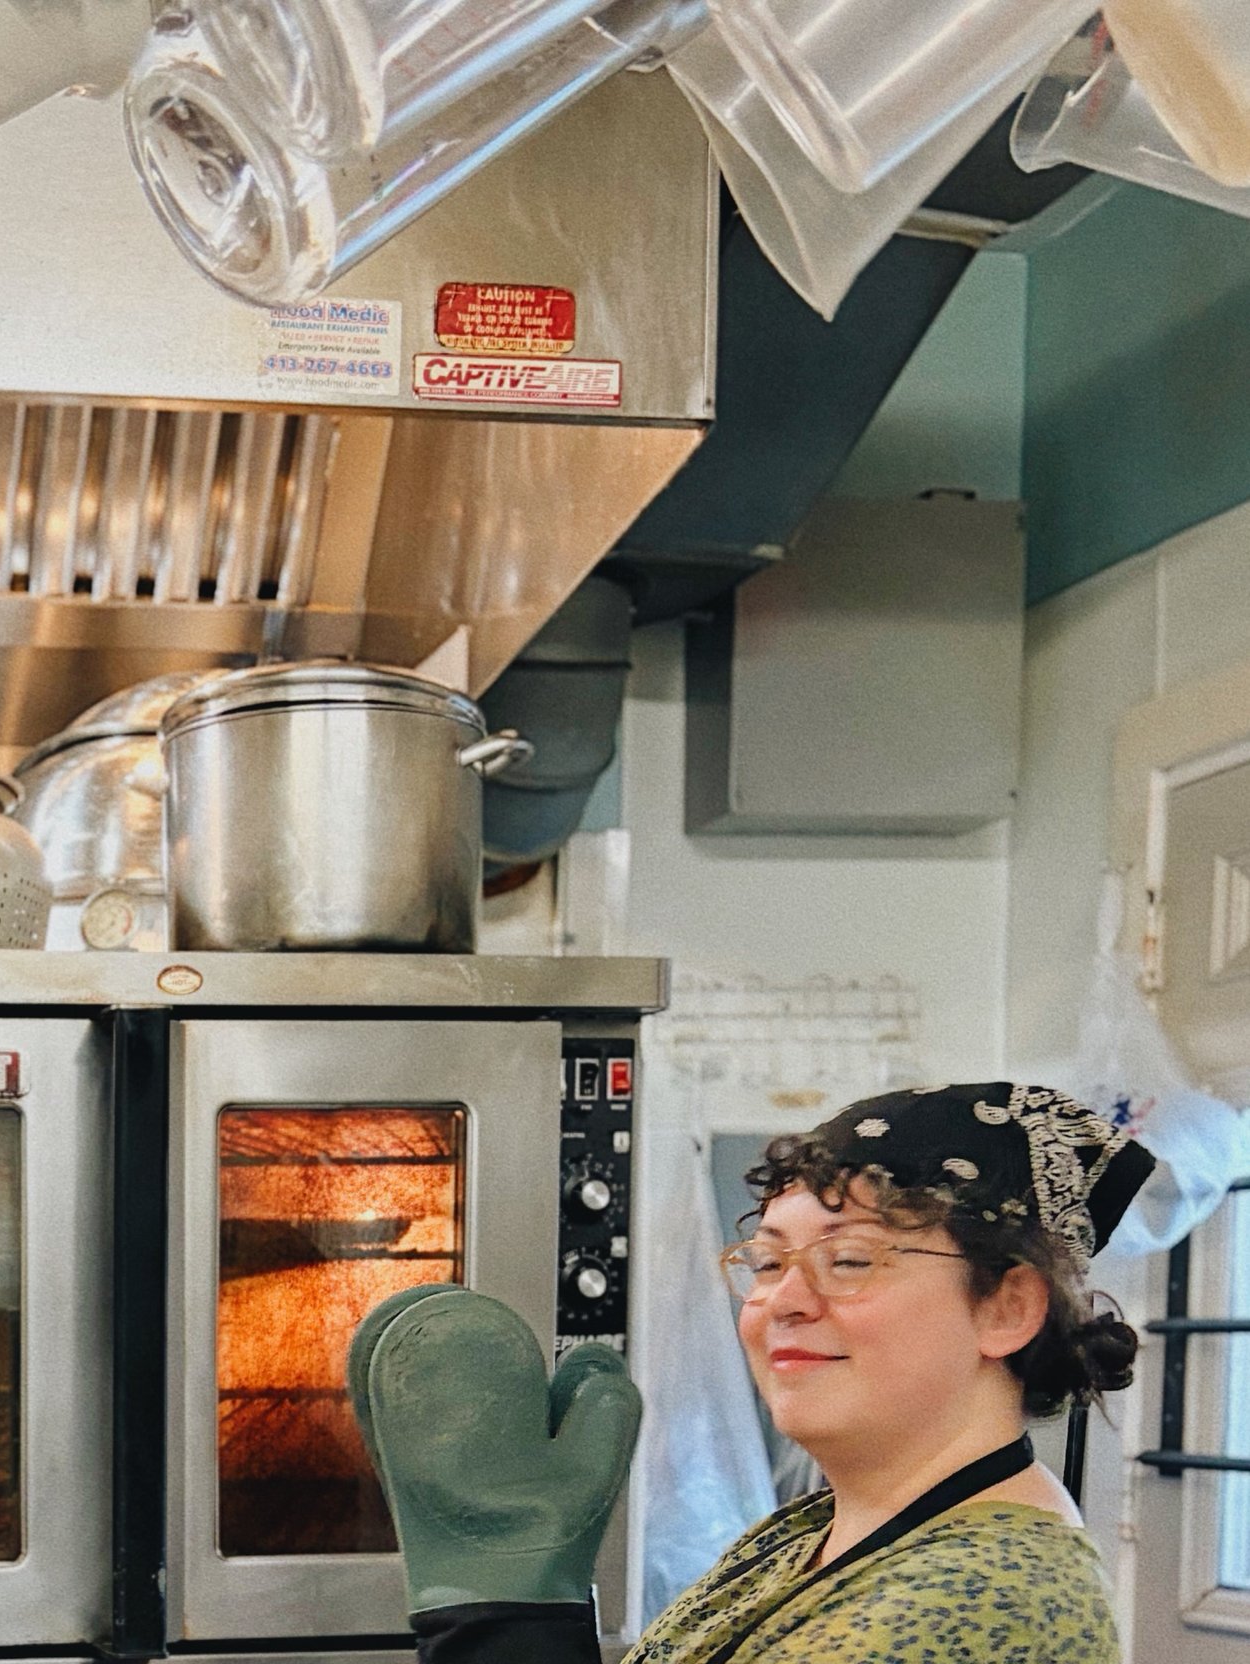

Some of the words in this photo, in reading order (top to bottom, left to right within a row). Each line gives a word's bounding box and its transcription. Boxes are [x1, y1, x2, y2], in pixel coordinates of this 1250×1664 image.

[477, 287, 535, 302] CAUTION
[328, 303, 390, 325] Medic
[271, 320, 324, 331] RESTAURANT
[327, 323, 364, 333] EXHAUST
[278, 342, 318, 352] Emergency
[347, 346, 381, 354] Available
[264, 355, 393, 378] 413-267-4663
